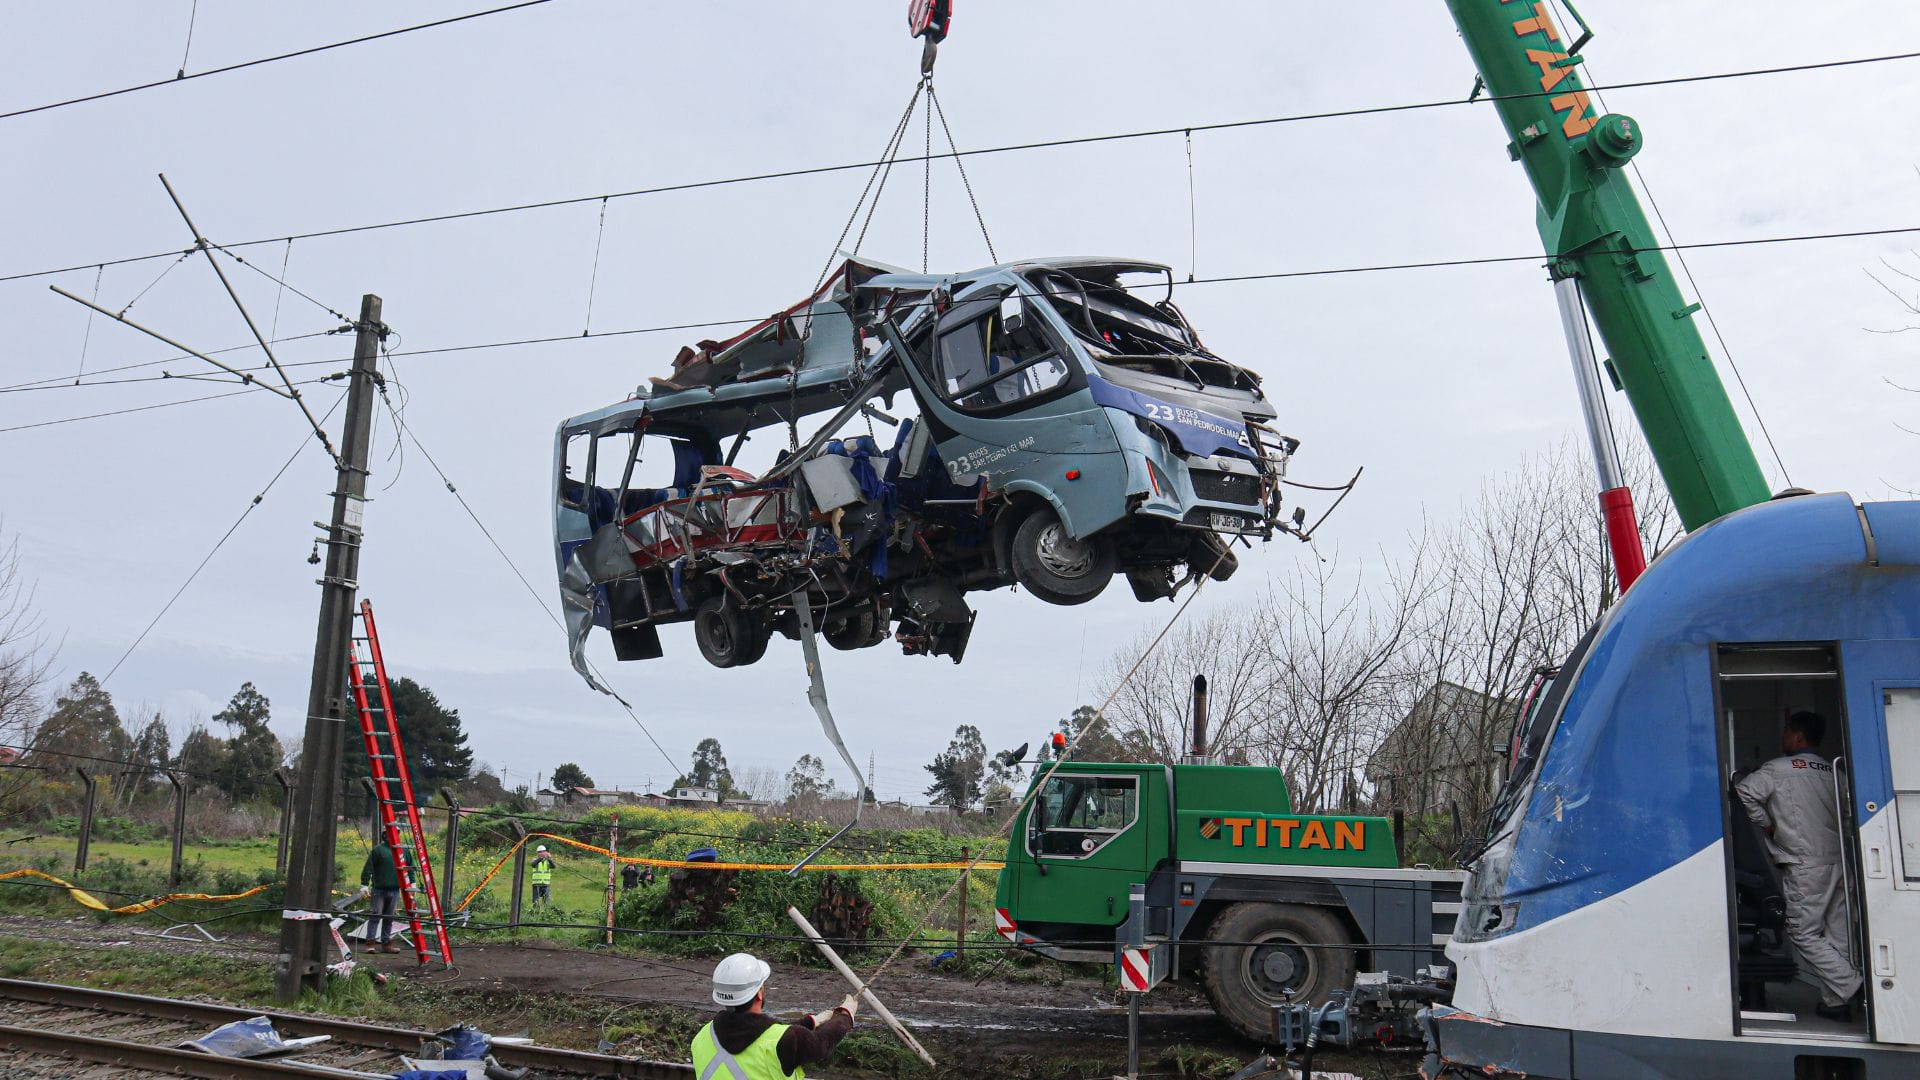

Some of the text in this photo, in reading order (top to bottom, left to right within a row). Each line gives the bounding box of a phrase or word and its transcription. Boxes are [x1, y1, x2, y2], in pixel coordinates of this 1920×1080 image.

[1500, 0, 1599, 140] TAN
[1146, 404, 1174, 420] 23
[1175, 407, 1198, 419] BUSES
[1178, 415, 1193, 425] SAN
[1194, 420, 1215, 432] PEDRO
[968, 446, 988, 460] BUSES
[947, 456, 971, 478] 23
[1223, 818, 1365, 850] TITAN
